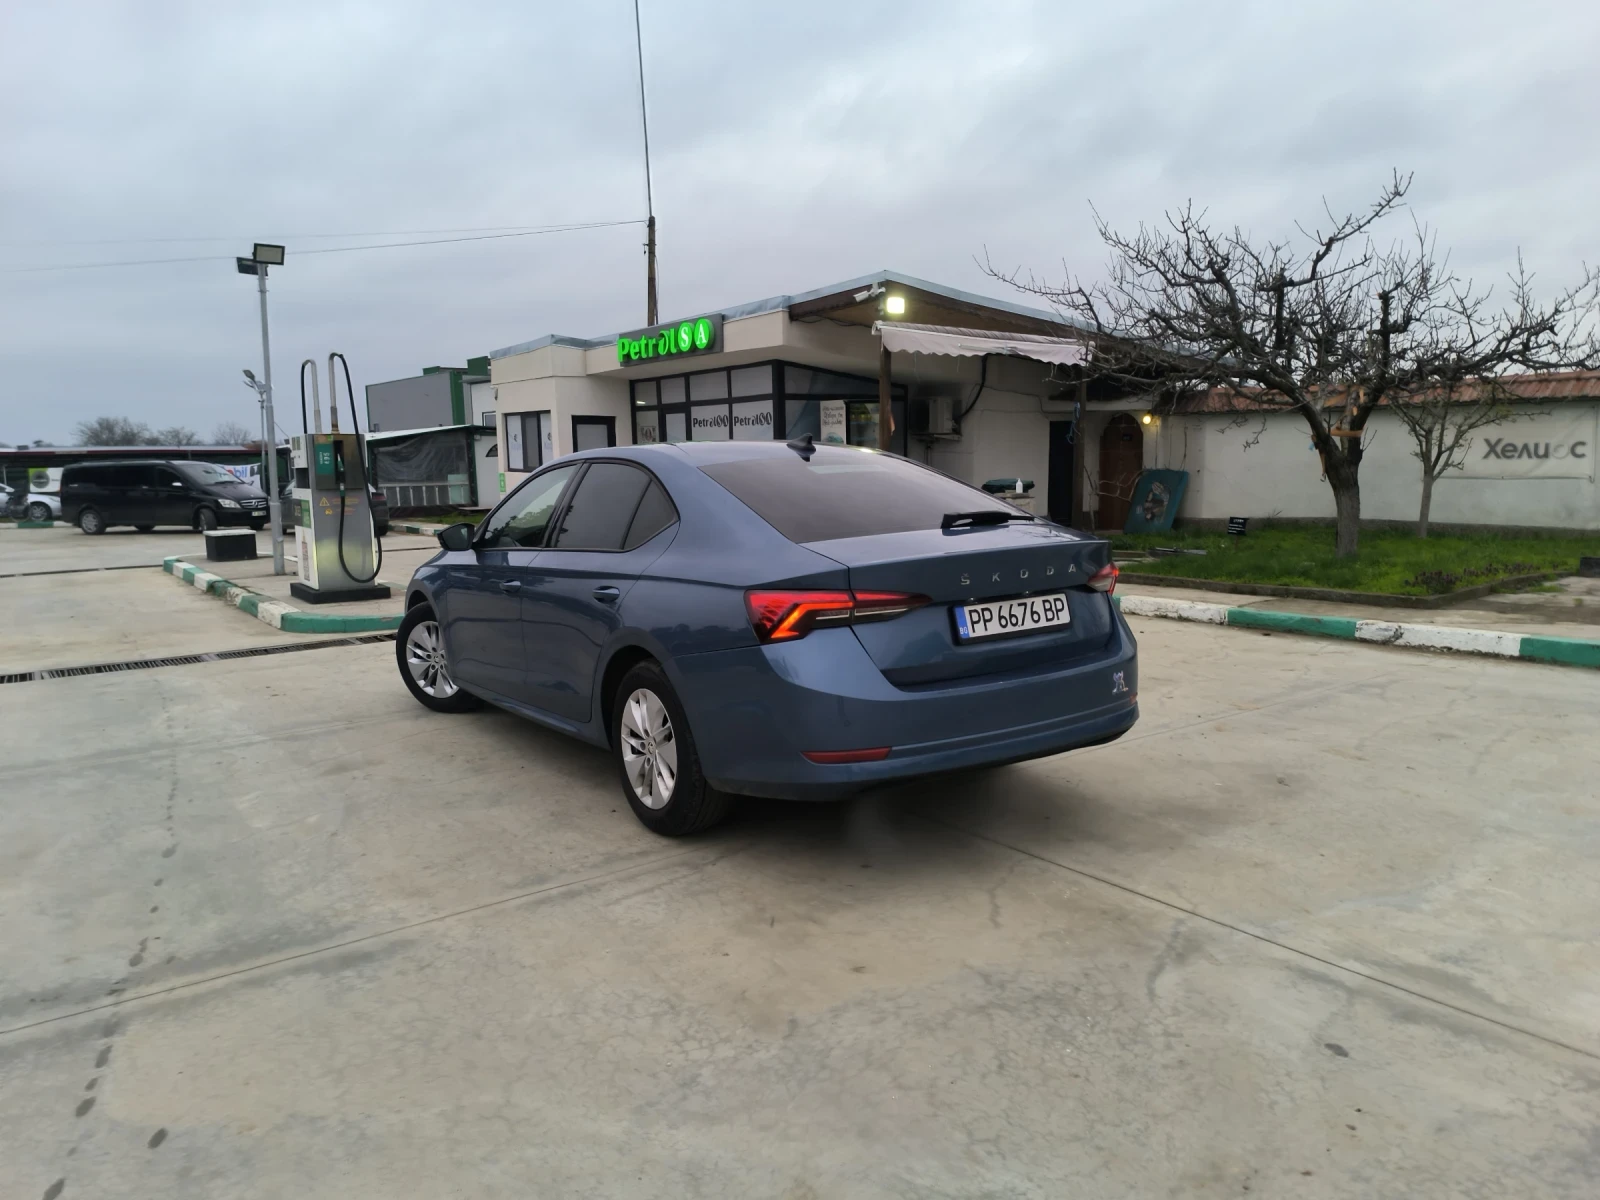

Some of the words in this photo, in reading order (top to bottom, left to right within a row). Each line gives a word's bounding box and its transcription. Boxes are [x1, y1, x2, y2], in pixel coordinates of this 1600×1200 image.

[968, 607, 993, 633] PP
[997, 600, 1041, 628] 6676
[1042, 598, 1065, 622] BP
[959, 626, 968, 635] BG
